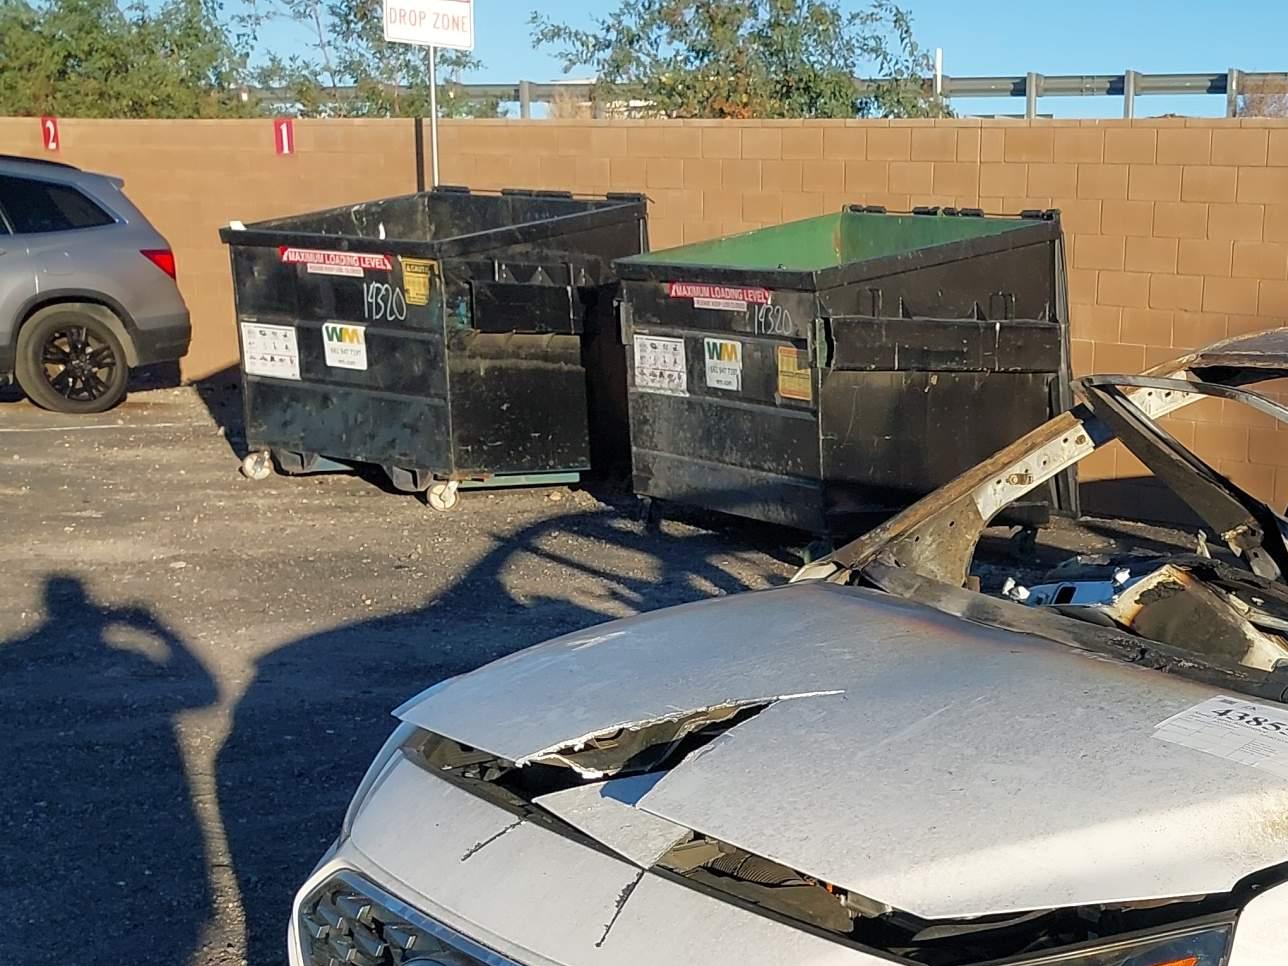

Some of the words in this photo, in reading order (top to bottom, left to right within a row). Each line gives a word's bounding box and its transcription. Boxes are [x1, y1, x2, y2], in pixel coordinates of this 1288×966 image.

[389, 7, 426, 27] DROP
[432, 12, 468, 32] ZONE
[45, 120, 57, 150] 2
[280, 122, 289, 154] 1
[288, 251, 324, 263] MAXIMUM
[325, 254, 359, 267] LOADING
[360, 256, 385, 269] LEVEL
[676, 284, 710, 297] MAXIMUM
[710, 287, 742, 300] LOADING
[743, 290, 766, 303] LEVEL
[325, 325, 362, 344] WM
[706, 341, 738, 361] WM
